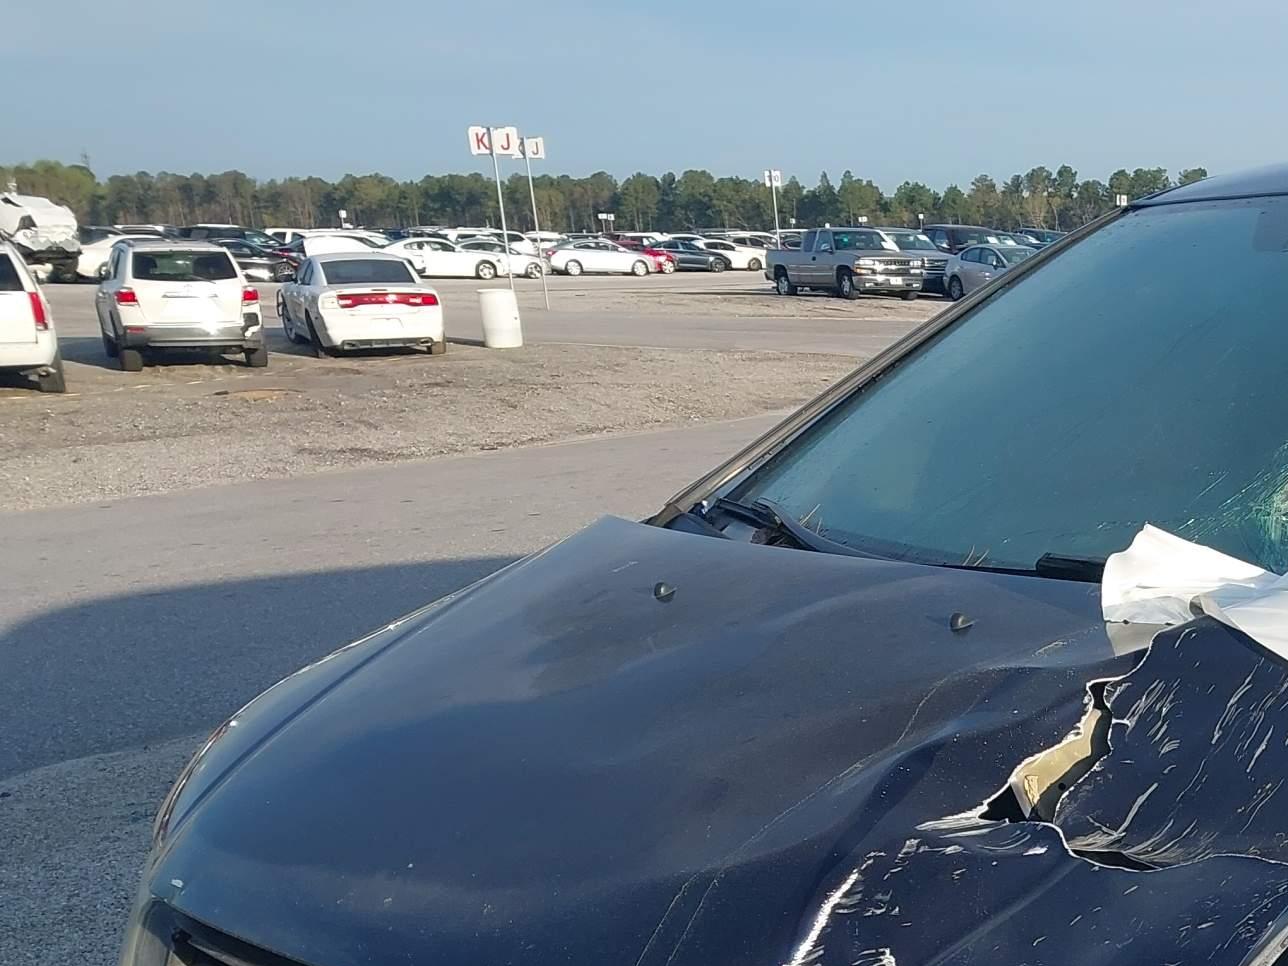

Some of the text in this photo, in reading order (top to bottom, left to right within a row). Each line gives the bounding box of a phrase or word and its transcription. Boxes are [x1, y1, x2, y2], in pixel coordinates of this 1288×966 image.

[475, 132, 511, 151] K J
[531, 141, 540, 156] J
